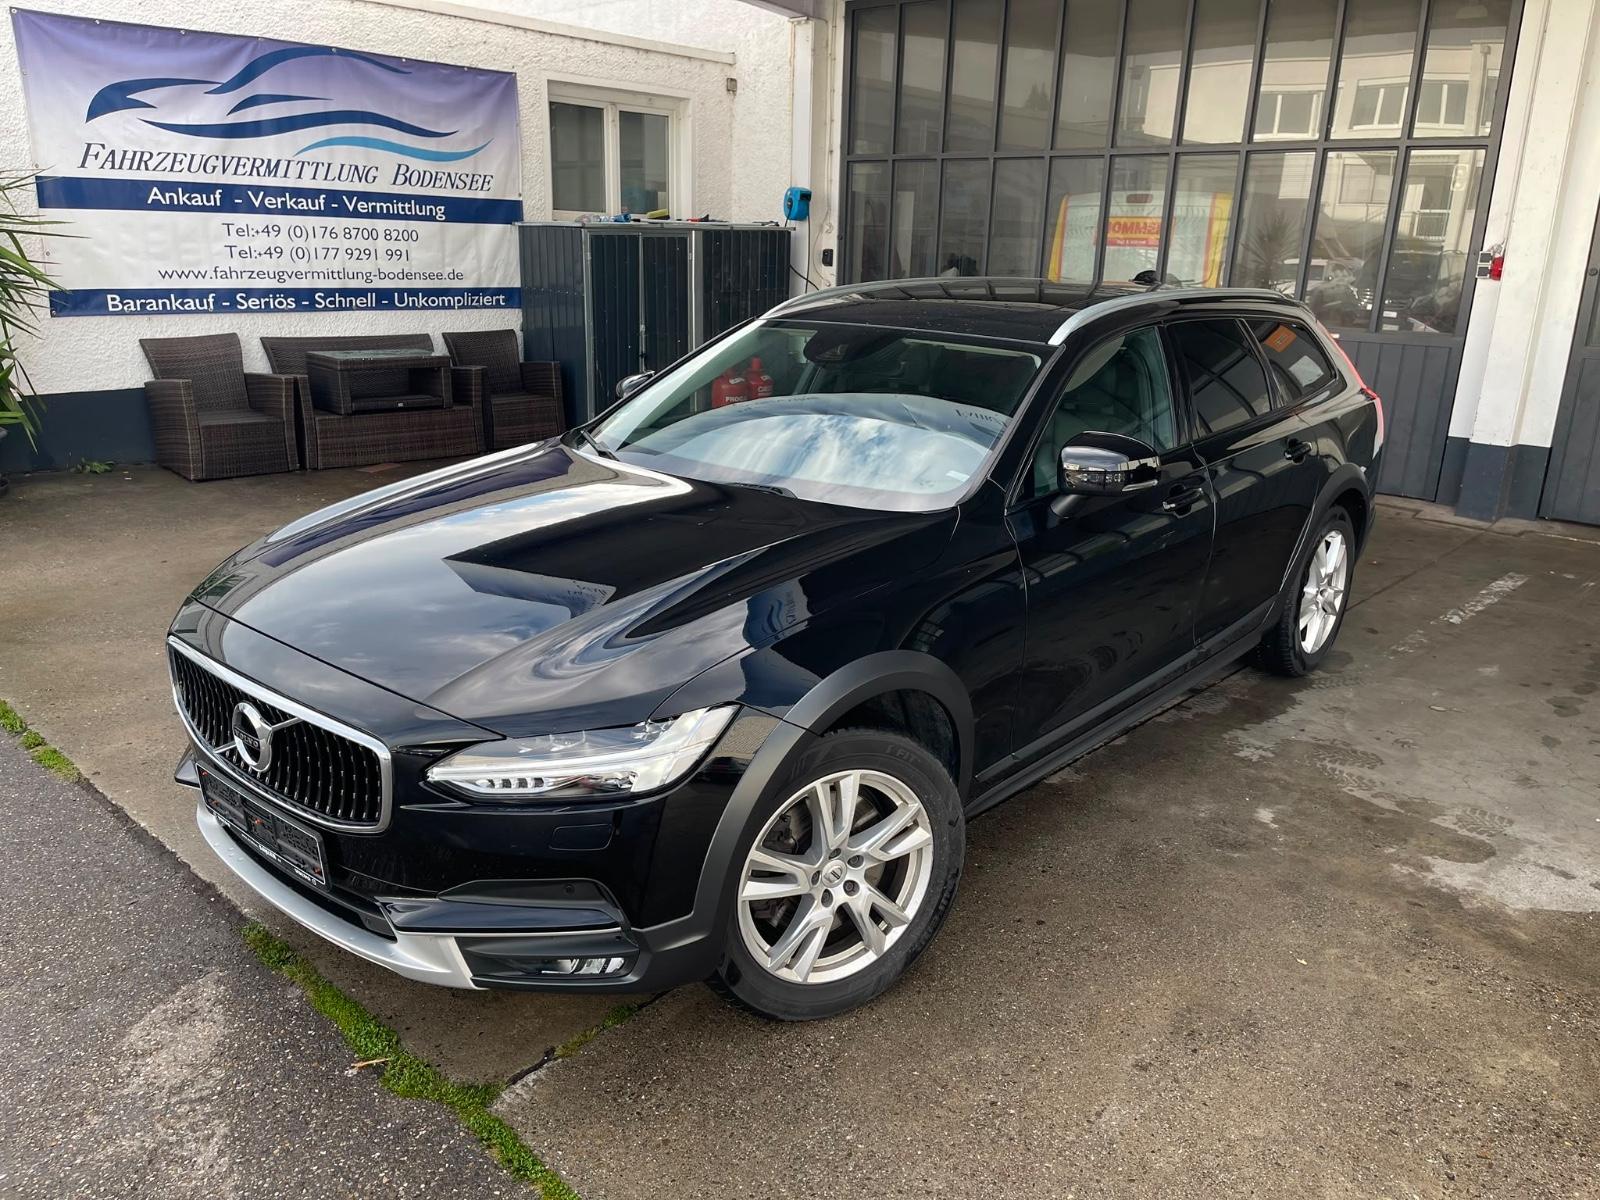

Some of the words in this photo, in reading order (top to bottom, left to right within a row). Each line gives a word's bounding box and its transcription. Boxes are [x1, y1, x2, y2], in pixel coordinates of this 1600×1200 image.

[77, 142, 379, 184] FAHRZEUGVERMITTLUNG
[390, 163, 494, 192] BODENSEE
[147, 186, 223, 207] Ankauf
[248, 190, 326, 211] Verkauf
[343, 195, 446, 221] Vermittlung
[221, 222, 281, 239] Tel:+49
[287, 224, 339, 243] (0)176
[343, 227, 379, 241] 8700
[384, 228, 419, 242] 8200
[224, 245, 284, 260] Tel:+49
[290, 246, 340, 264] (0)177
[345, 247, 378, 262] 9291
[385, 249, 410, 262] 991
[158, 266, 464, 284] www.fahrzeugvermittlung-bodensee.de
[106, 293, 216, 312] Barankauf
[236, 292, 296, 310] Seriös
[314, 292, 376, 308] Schnell
[394, 291, 506, 310] Unkompliziert
[235, 728, 259, 748] VOLVO
